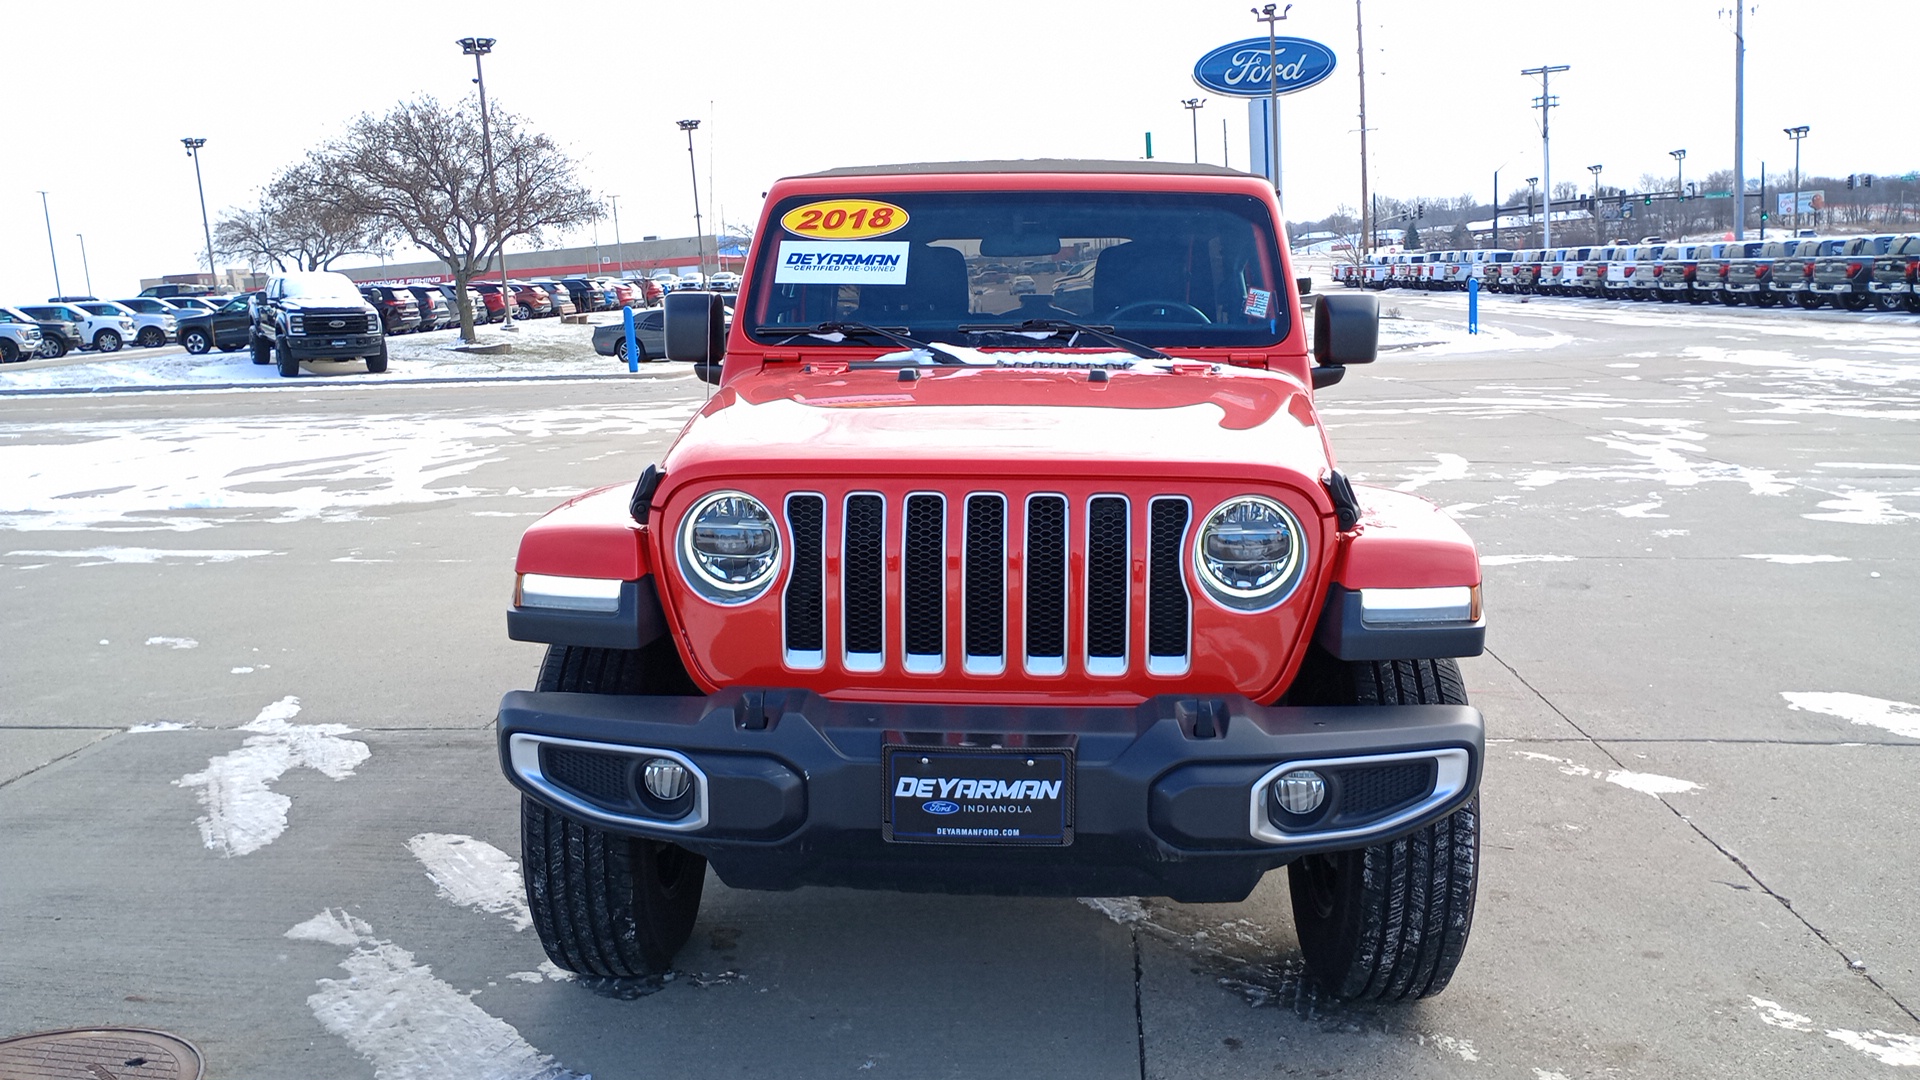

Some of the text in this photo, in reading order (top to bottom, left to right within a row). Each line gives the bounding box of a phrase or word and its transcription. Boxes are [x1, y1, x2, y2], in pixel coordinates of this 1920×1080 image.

[1224, 48, 1307, 85] Ford
[795, 207, 894, 231] 2018
[786, 253, 901, 266] DEYARMAN
[406, 276, 441, 284] FISHING
[895, 777, 1062, 800] DEYARMAN
[929, 802, 1032, 814] Ford INDIANOLA
[937, 827, 1020, 836] DEYARMANFORD.COM
